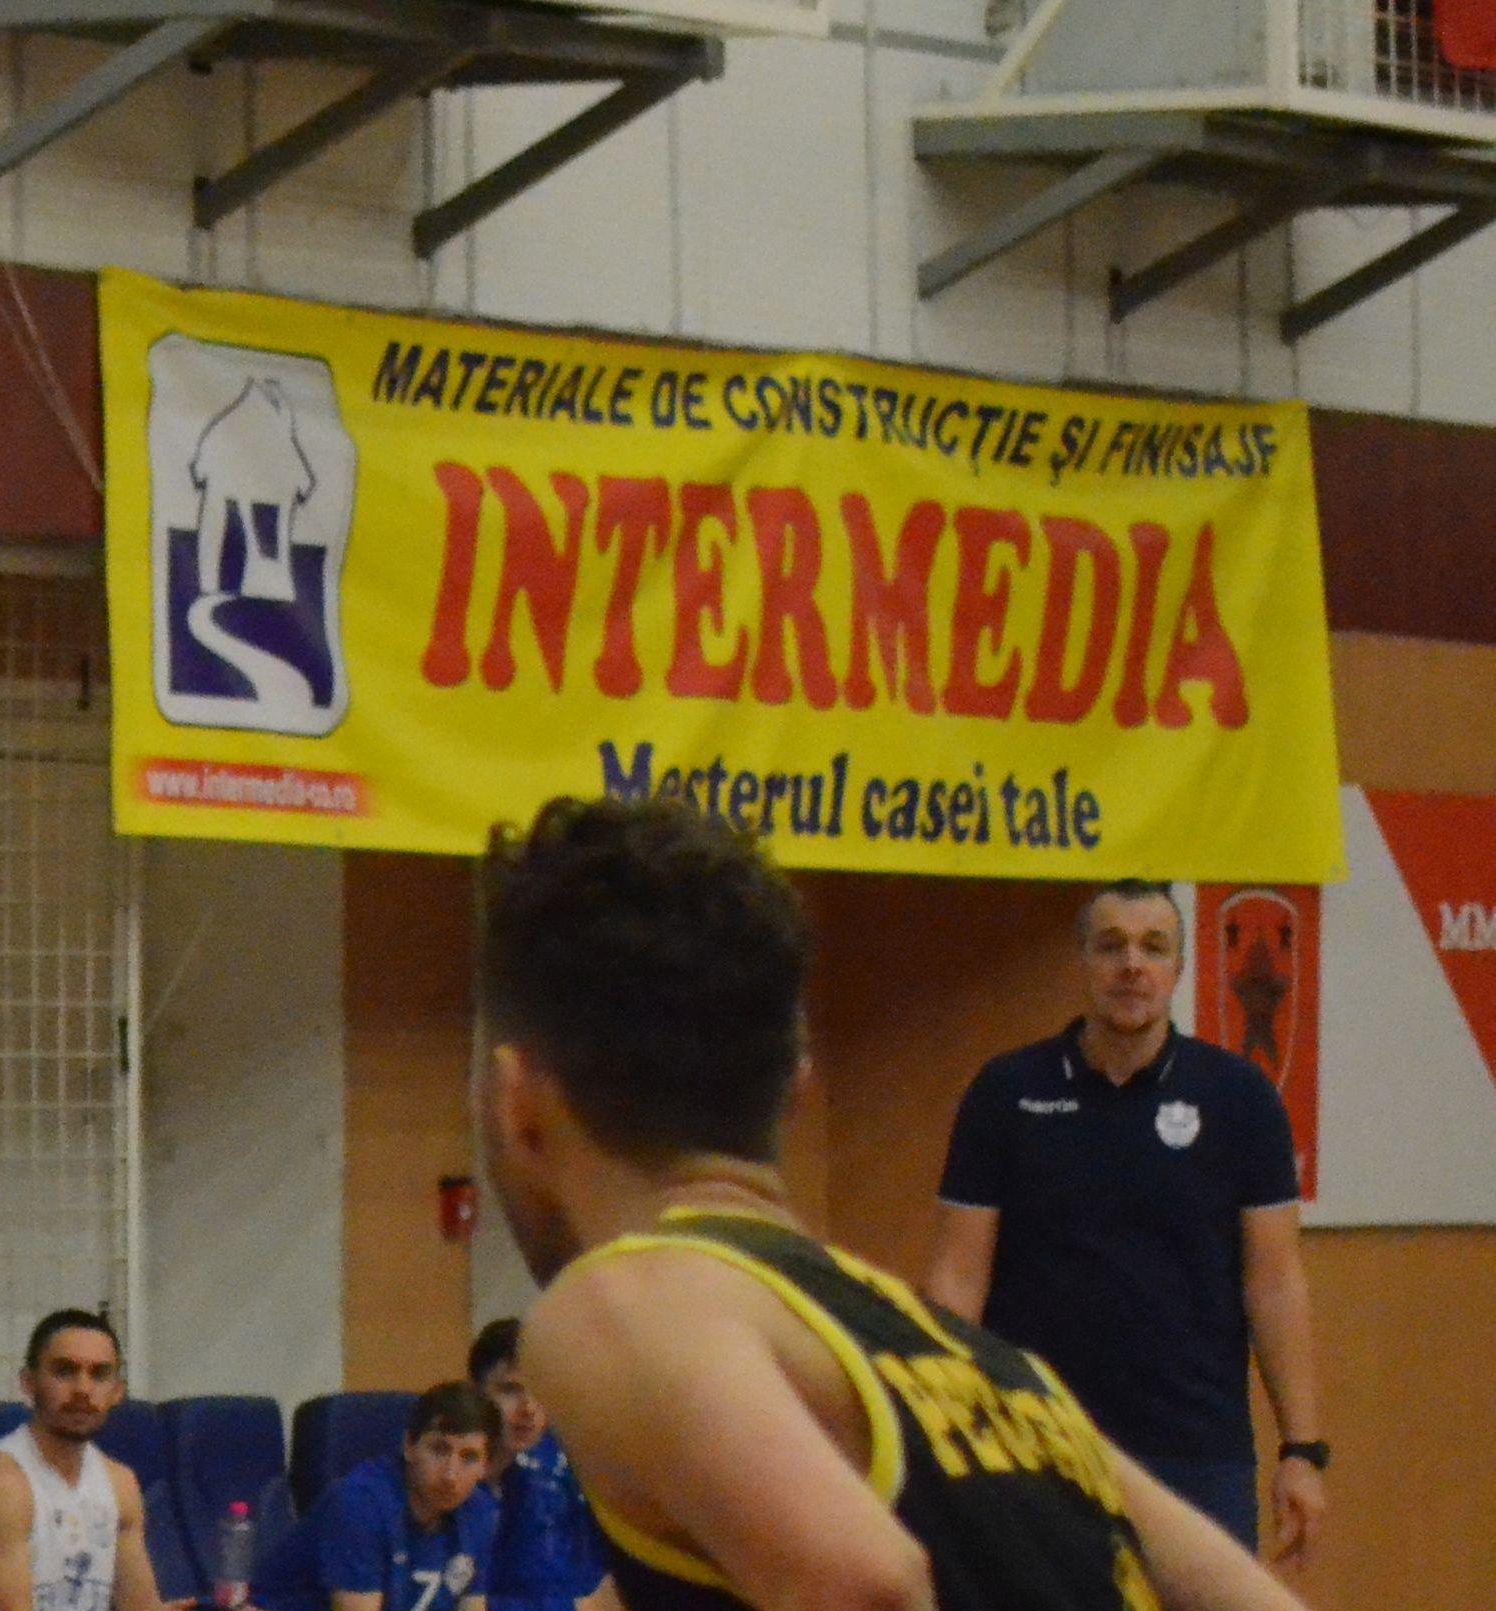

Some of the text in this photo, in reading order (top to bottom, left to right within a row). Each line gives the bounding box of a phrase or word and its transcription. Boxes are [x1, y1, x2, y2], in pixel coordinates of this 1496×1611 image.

[373, 341, 643, 426] MATERIALE
[652, 371, 712, 430] DE
[422, 460, 1250, 731] INTERMEDIA
[861, 761, 991, 845] casei
[1000, 767, 1102, 850] tale
